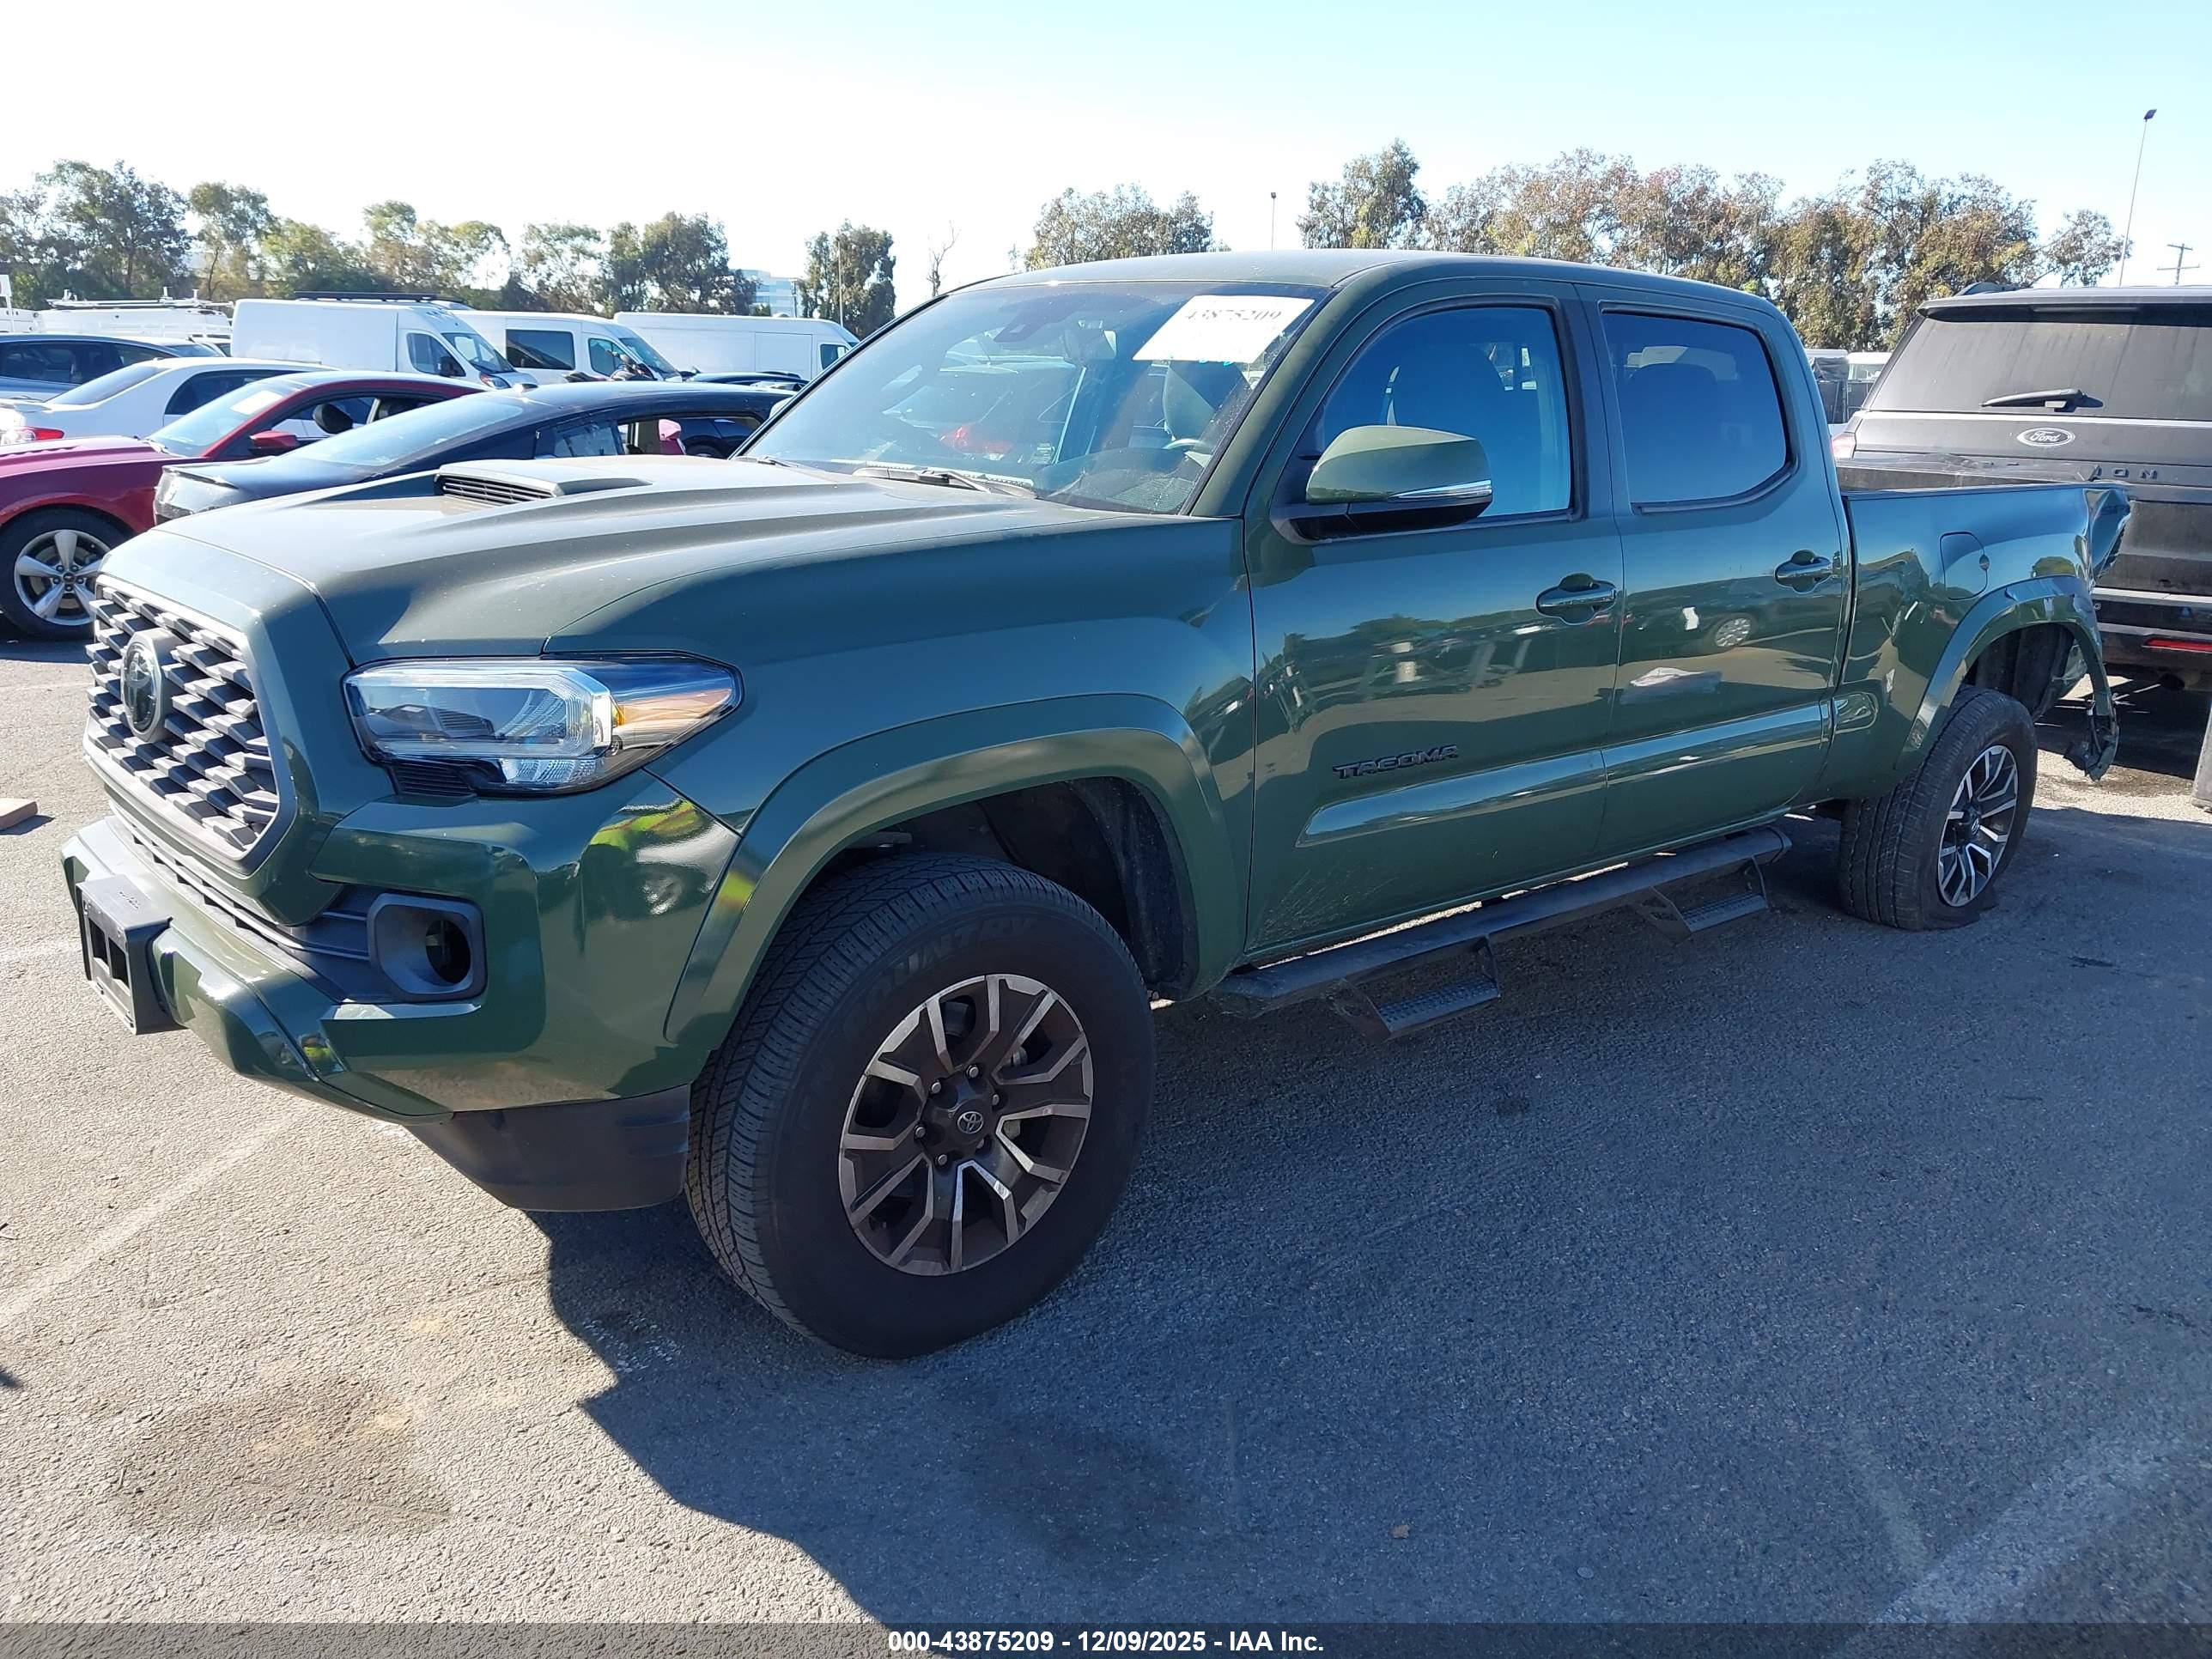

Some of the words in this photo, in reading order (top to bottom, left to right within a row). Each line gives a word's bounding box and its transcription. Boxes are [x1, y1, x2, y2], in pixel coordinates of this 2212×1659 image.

[2030, 429, 2060, 443] Ford
[1332, 744, 1459, 780] TACOMA
[844, 917, 1037, 1036] COUNTRY
